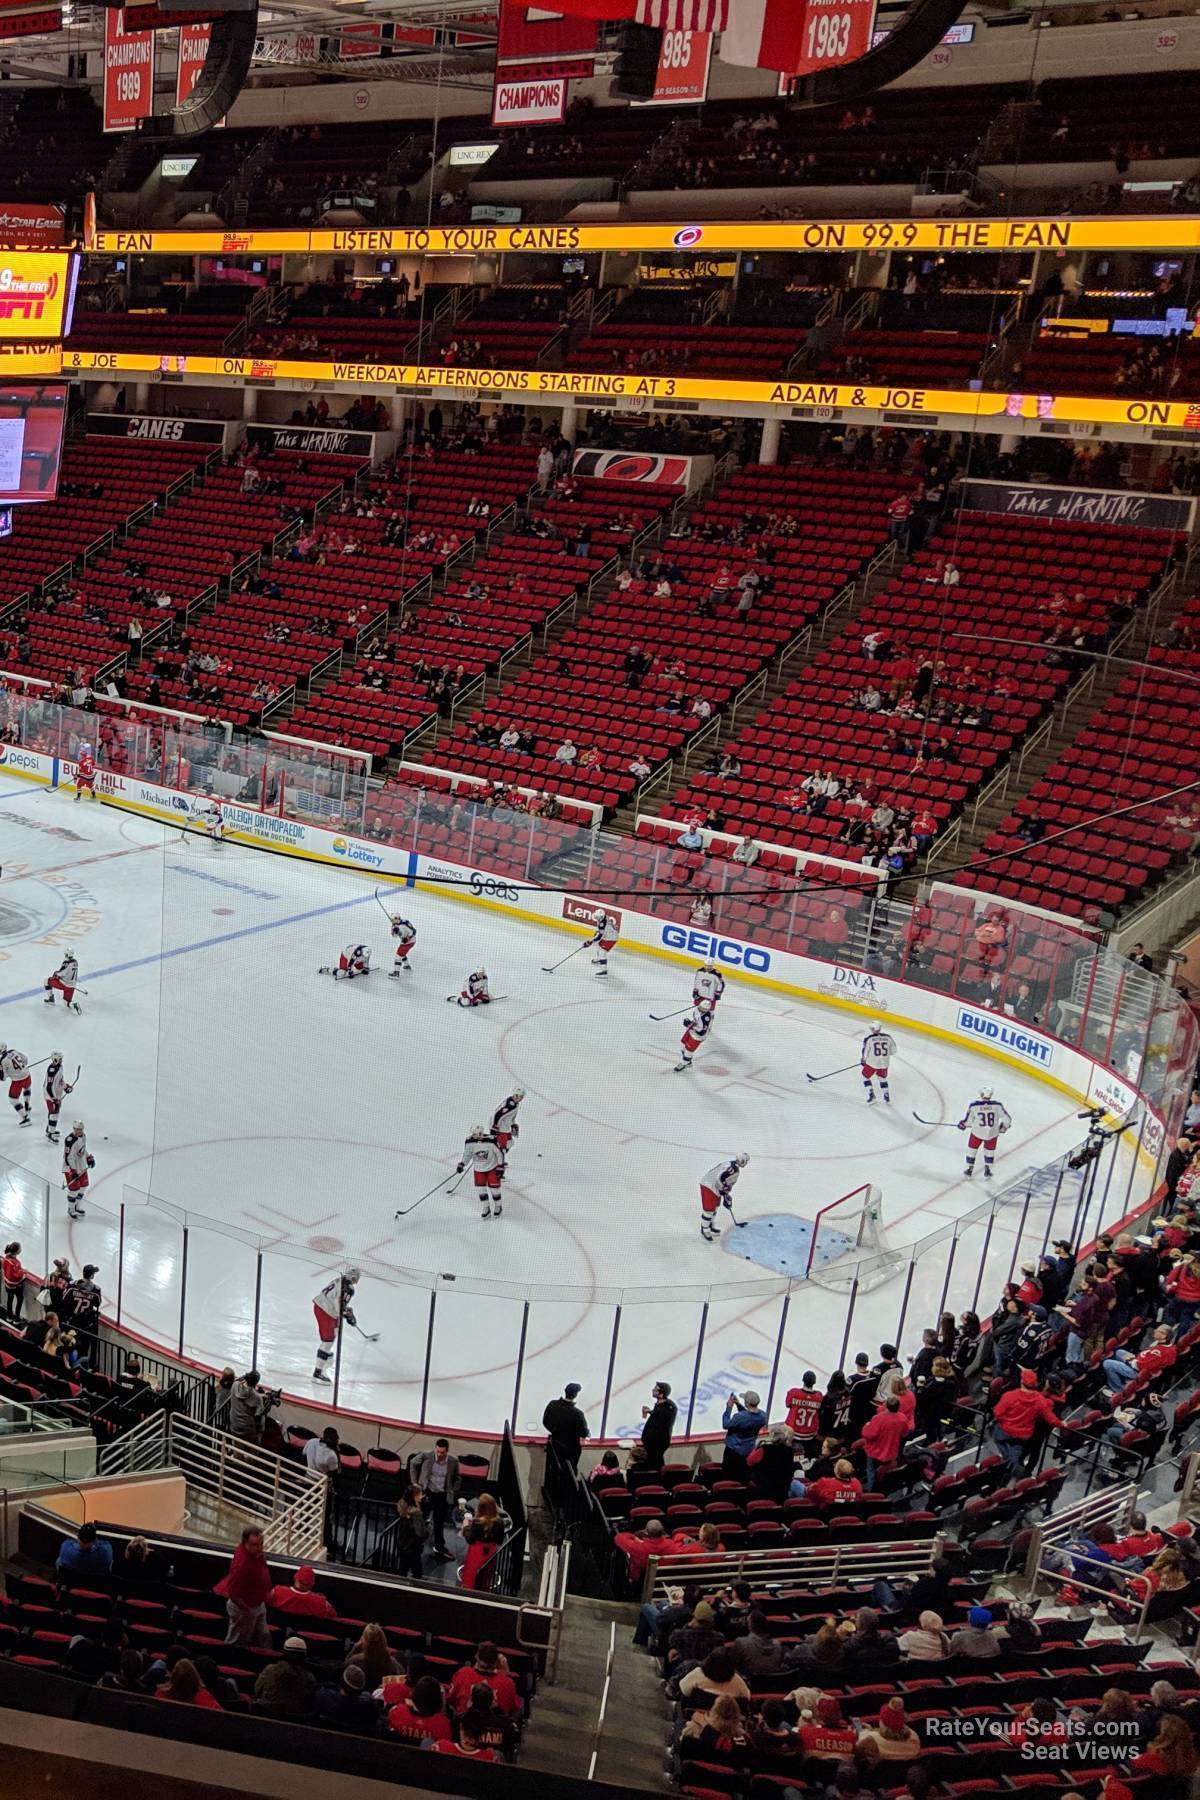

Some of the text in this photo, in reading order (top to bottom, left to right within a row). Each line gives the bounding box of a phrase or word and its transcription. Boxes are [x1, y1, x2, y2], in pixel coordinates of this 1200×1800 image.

[808, 14, 851, 58] 1983
[107, 41, 150, 67] CHAMPIONS
[662, 30, 691, 69] 985
[116, 71, 141, 101] 1989
[499, 85, 560, 110] CHAMPIONS
[457, 150, 492, 161] UNC REX
[164, 163, 180, 172] UNC
[117, 234, 152, 250] FAN
[333, 227, 580, 250] LISTEN TO YOUR CANES
[803, 222, 1071, 247] ON 99.9 THE FAN
[11, 281, 48, 292] THE FAN
[73, 354, 117, 367] & JOE
[223, 360, 244, 374] ON
[333, 364, 676, 396] WEEKDAY AFTERNOONS STARTING AT 3
[770, 385, 925, 409] ADAM & JOE
[1126, 402, 1170, 423] ON
[127, 418, 185, 441] CANES
[273, 428, 351, 454] TAKE WARNING
[1006, 490, 1147, 522] TAKE WARNING
[8, 751, 40, 770] pepsi
[101, 772, 127, 791] HILL
[140, 789, 172, 807] Michael
[223, 806, 305, 839] RALEIGH ORTHOPAEDIC
[254, 828, 297, 845] TEAM DOCTORS
[348, 847, 384, 867] Lottery
[428, 865, 463, 879] ANALYTICS
[484, 877, 519, 902] sas
[31, 882, 102, 947] PNC ARENA
[662, 925, 771, 973] GEICO
[833, 967, 876, 992] DNA
[960, 1013, 1052, 1063] BUD LIGHT
[873, 1042, 888, 1057] 65
[977, 1112, 995, 1127] 38
[795, 1408, 817, 1427] 37
[833, 1407, 850, 1428] 74
[835, 1490, 856, 1499] SLAVIN
